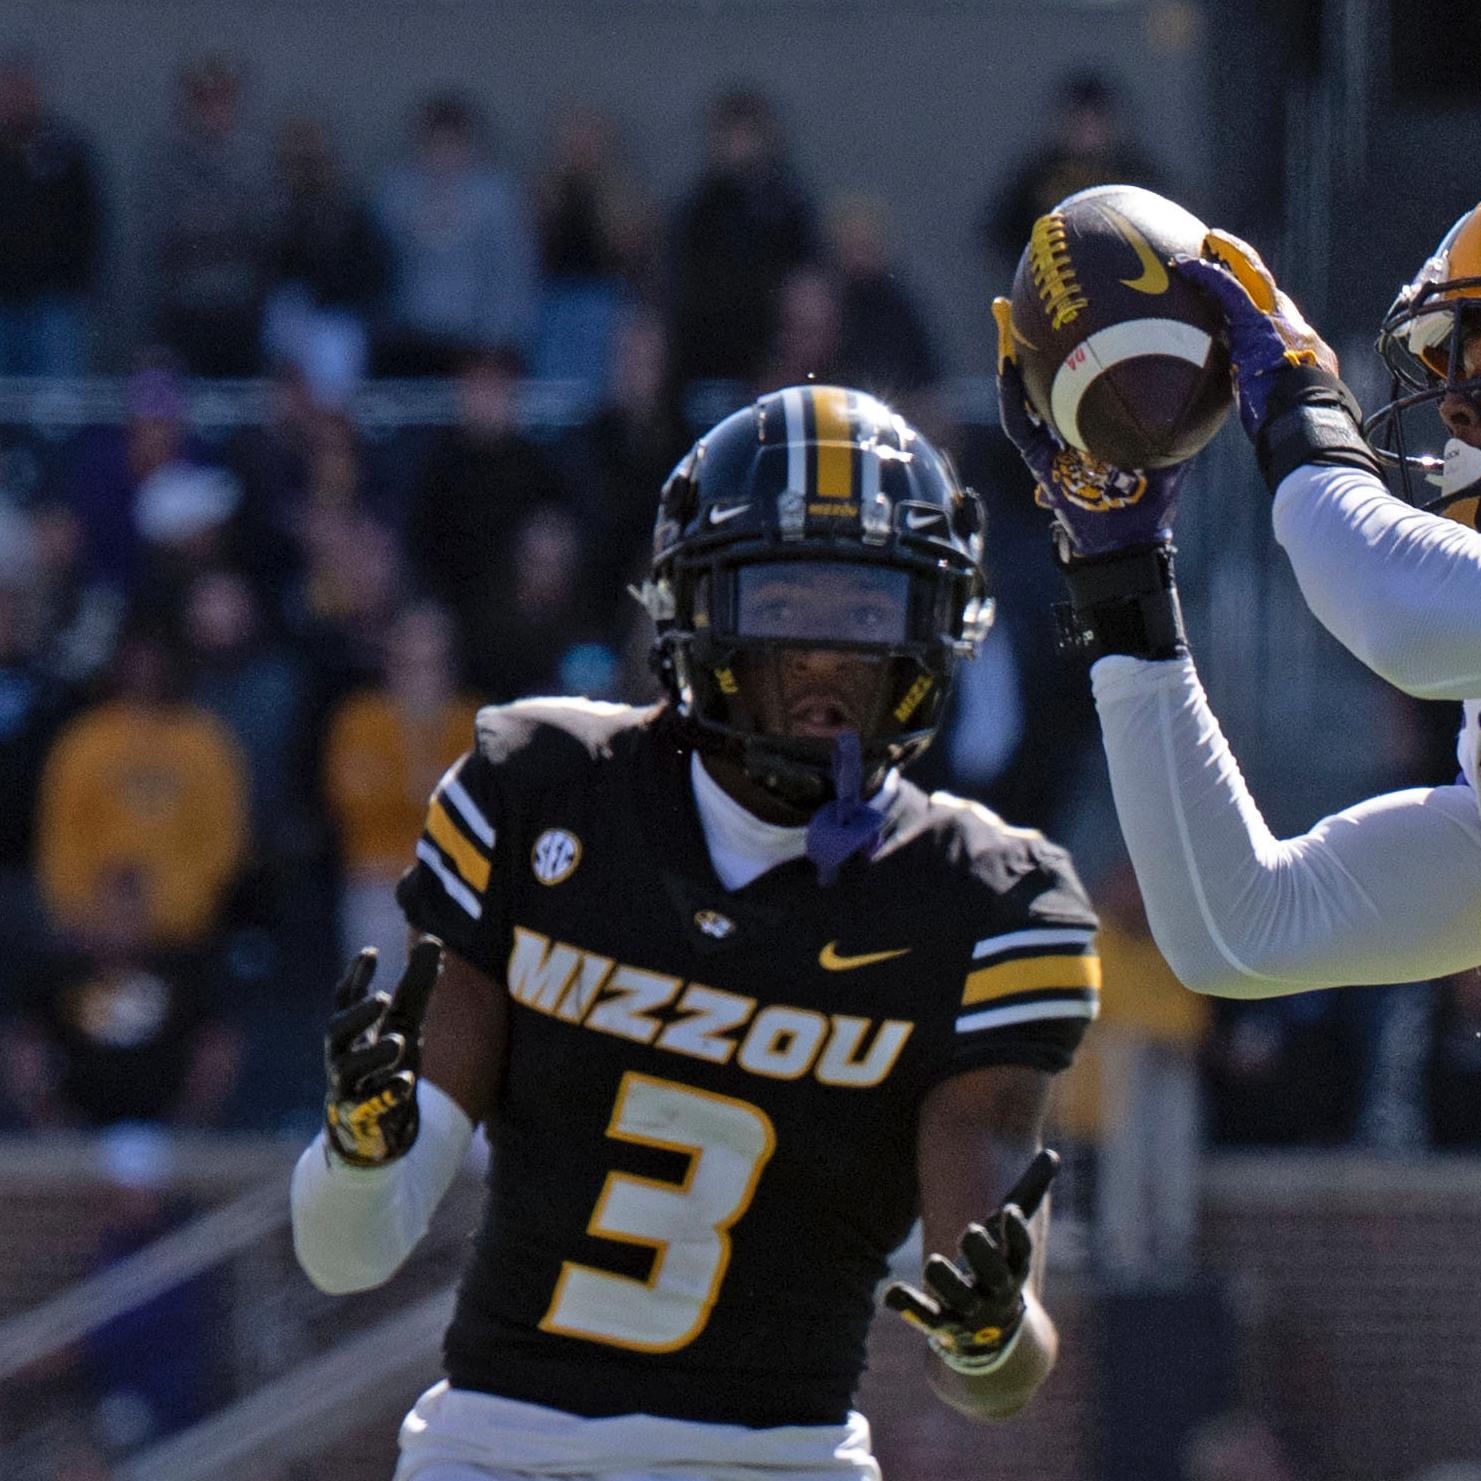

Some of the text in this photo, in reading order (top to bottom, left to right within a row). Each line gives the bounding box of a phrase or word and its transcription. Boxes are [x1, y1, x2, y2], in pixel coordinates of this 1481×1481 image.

[534, 831, 577, 880] SEC
[507, 925, 915, 1088] MIZZOU
[538, 1070, 778, 1354] 3
